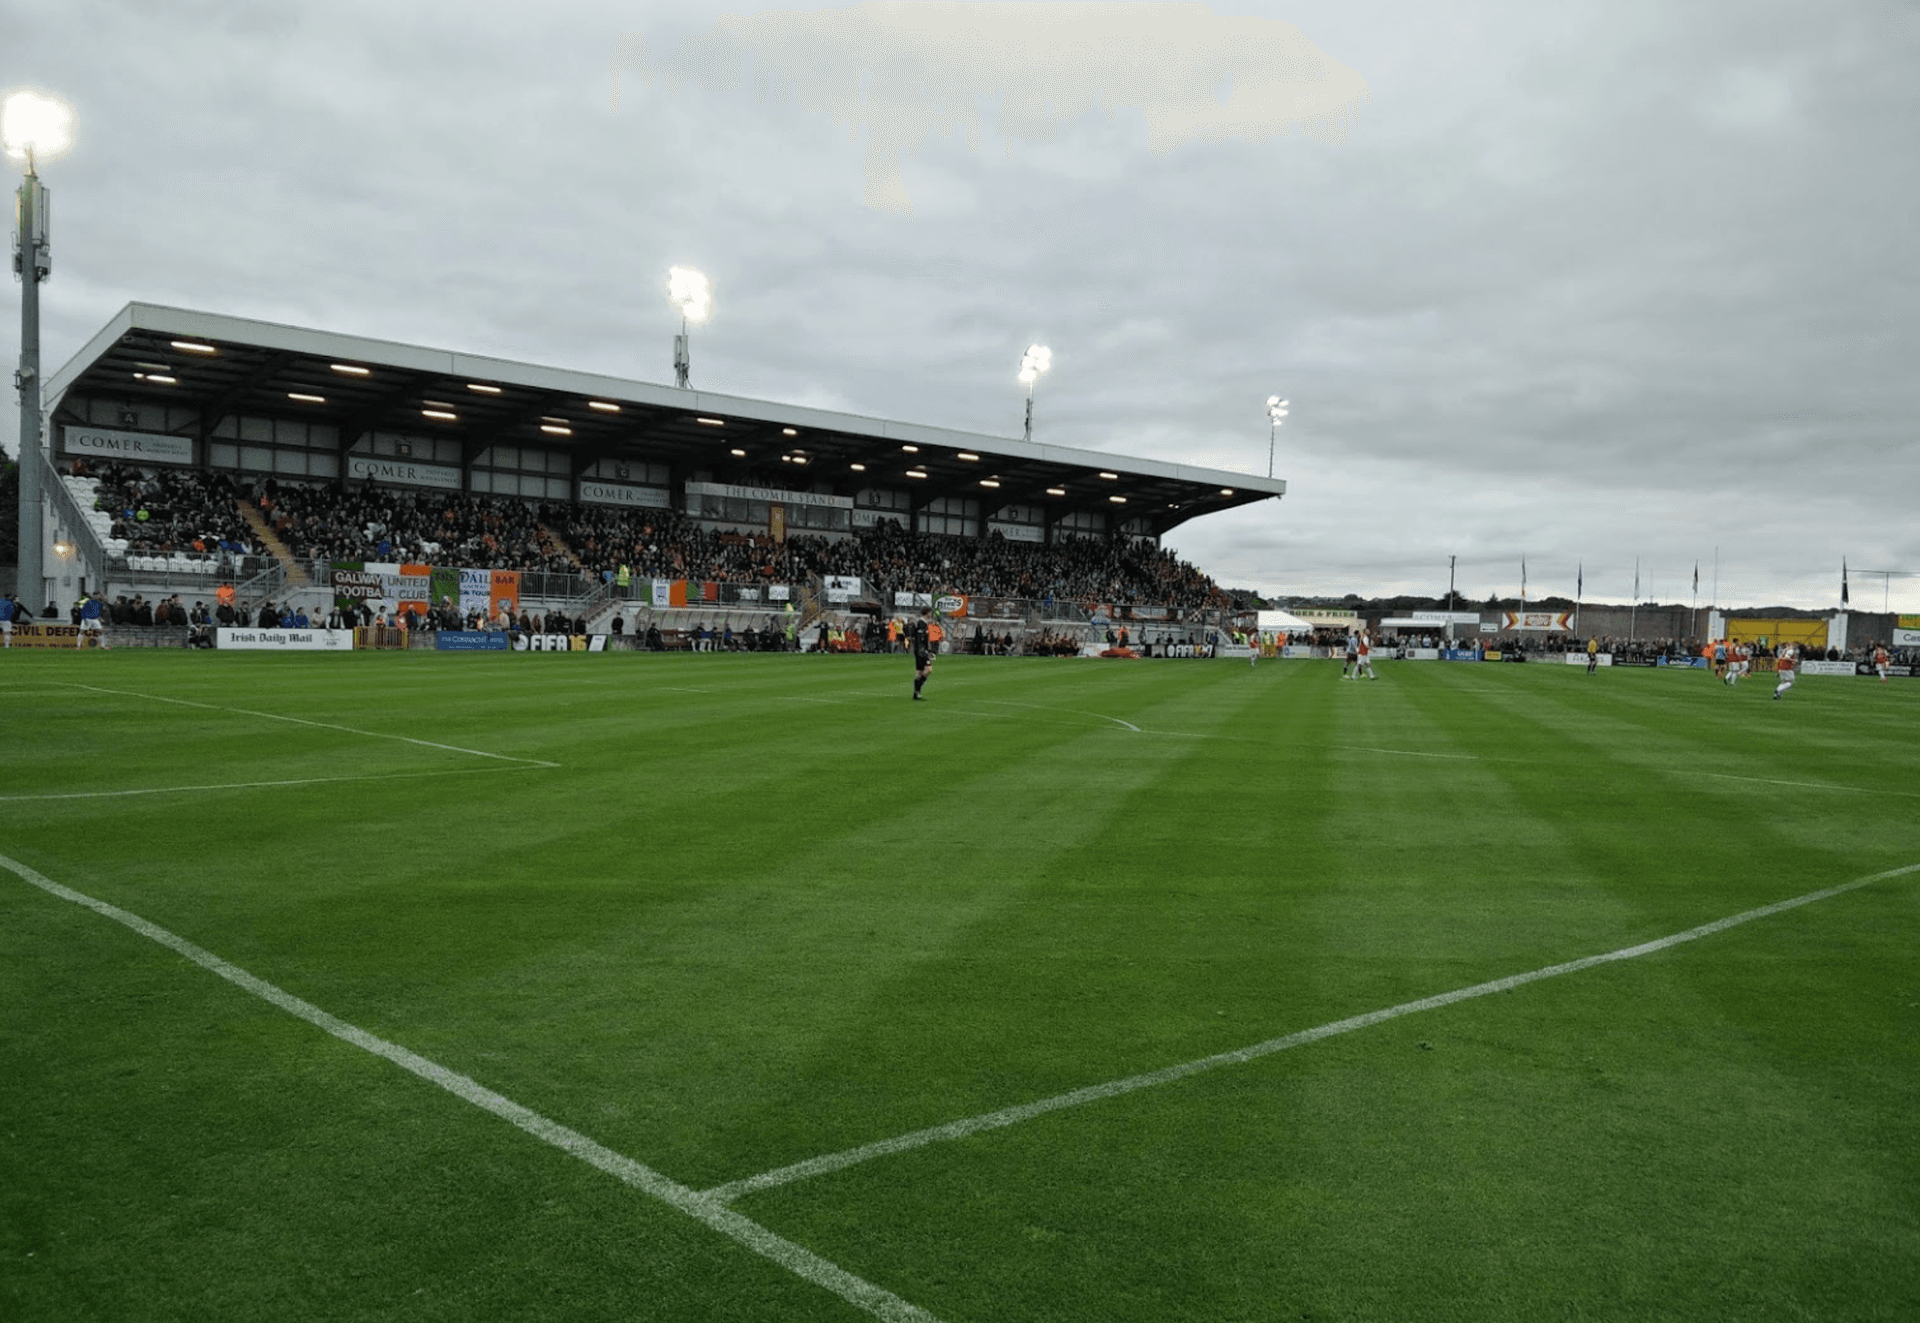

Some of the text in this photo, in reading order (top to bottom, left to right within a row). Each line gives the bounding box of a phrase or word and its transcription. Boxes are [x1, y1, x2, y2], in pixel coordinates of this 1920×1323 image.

[79, 435, 143, 452] COMER
[354, 461, 418, 480] COMER
[583, 486, 634, 502] COMER
[725, 486, 836, 506] THE COMER STAND
[335, 571, 429, 588] GALWAY UNITED
[335, 585, 428, 599] FOOTBALL CLUB
[11, 626, 102, 637] CIVIL DEFECE
[231, 632, 256, 643] Irish
[259, 633, 287, 645] Daily
[289, 633, 314, 643] Mail
[530, 634, 568, 651] FIFA
